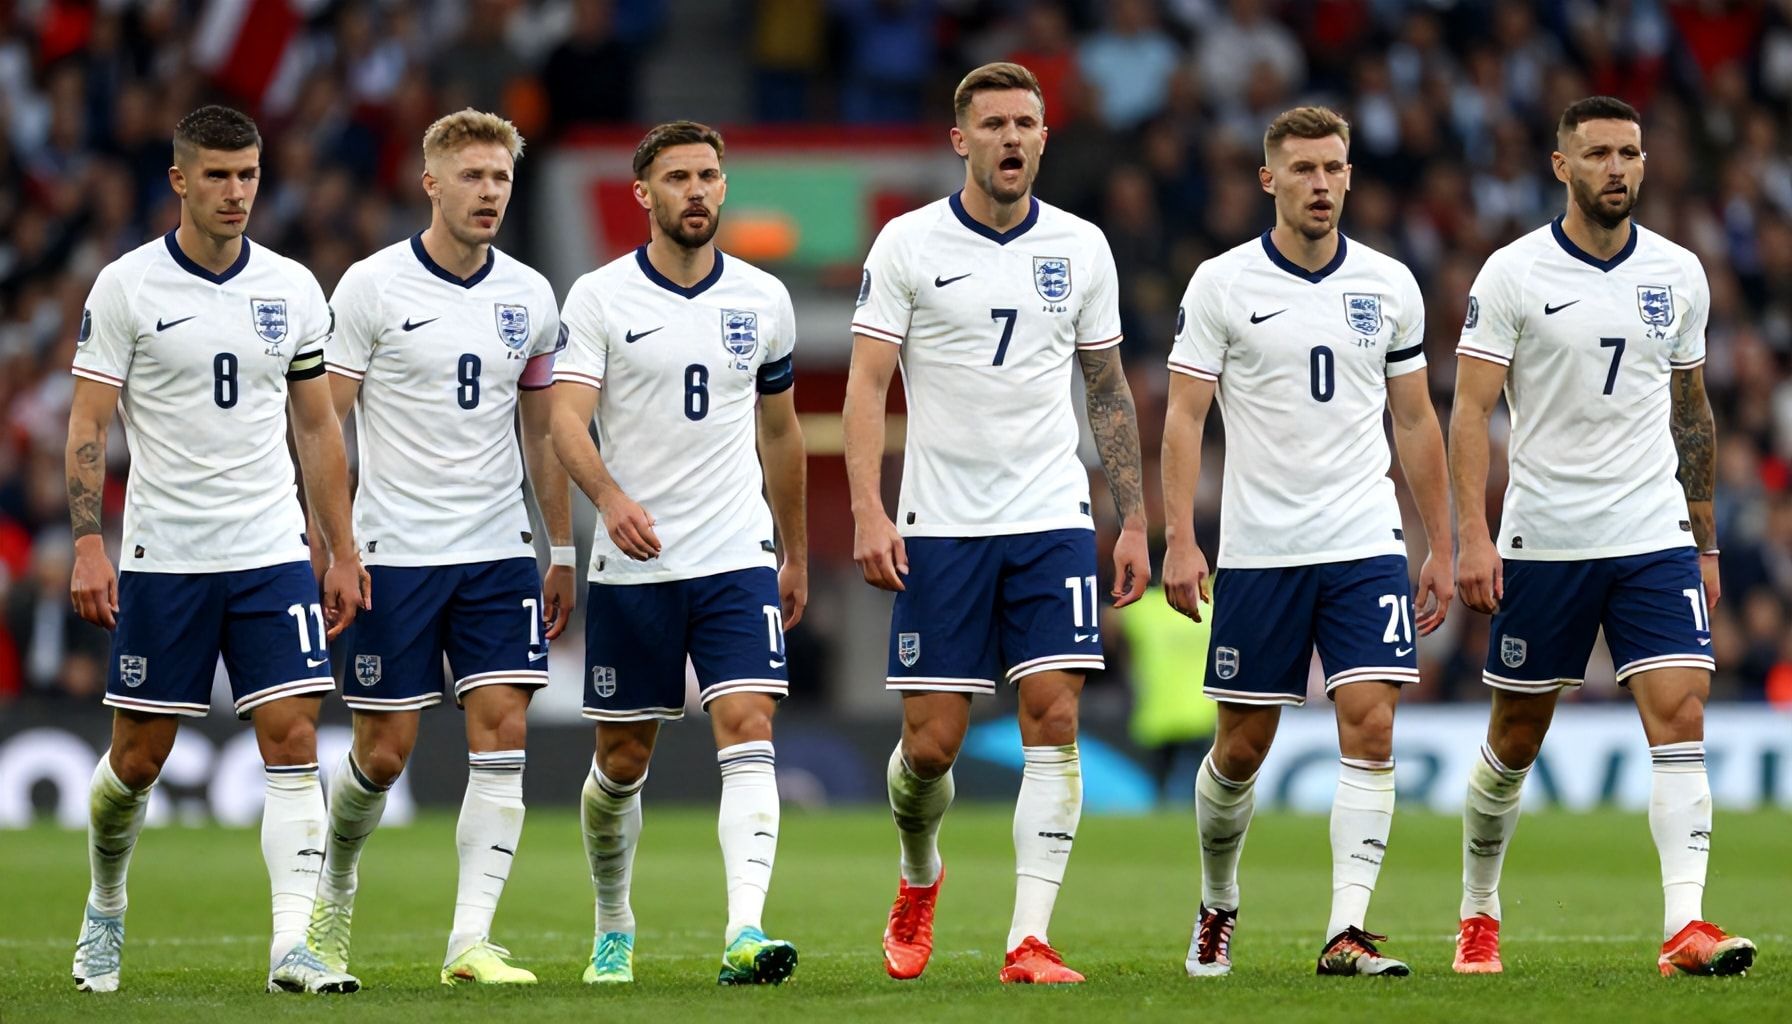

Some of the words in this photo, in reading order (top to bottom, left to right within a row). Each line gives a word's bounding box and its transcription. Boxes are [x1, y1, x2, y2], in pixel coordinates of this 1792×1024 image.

[990, 308, 1018, 367] 7
[1599, 337, 1626, 396] 7
[213, 352, 239, 410] 8
[1310, 345, 1335, 403] 0
[1065, 575, 1098, 628] 11
